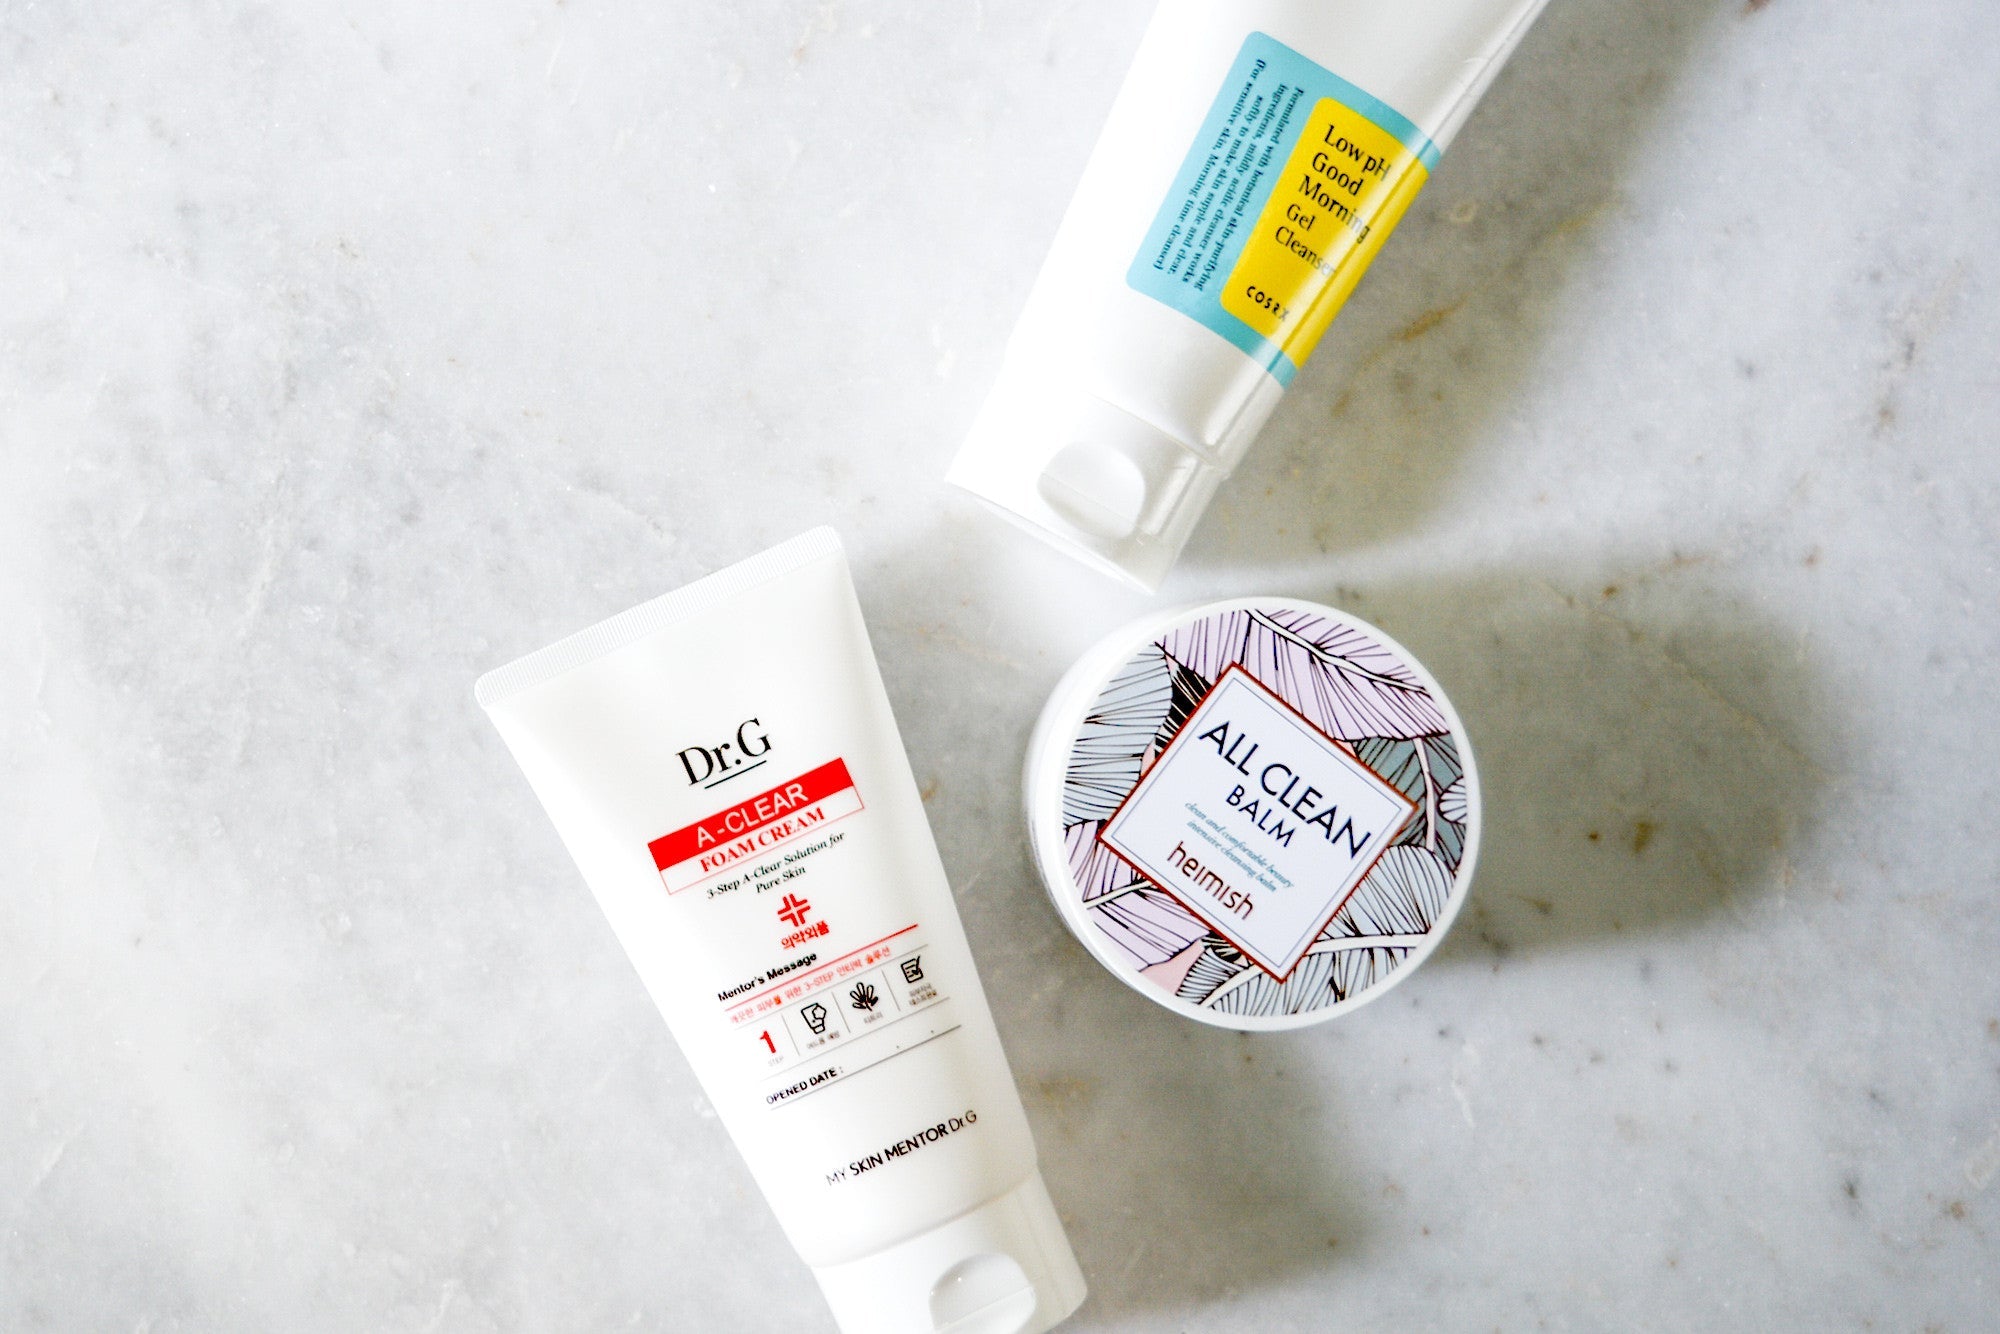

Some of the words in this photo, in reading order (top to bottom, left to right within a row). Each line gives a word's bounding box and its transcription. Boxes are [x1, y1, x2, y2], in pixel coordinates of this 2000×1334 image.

[1249, 58, 1267, 80] (For
[1227, 81, 1254, 126] sensitive
[1244, 94, 1264, 125] softly
[1270, 86, 1305, 145] Formulated
[1223, 138, 1242, 167] make
[1238, 126, 1250, 137] to
[1324, 124, 1364, 162] Low
[1362, 156, 1391, 182] pH
[1188, 153, 1220, 198] Morning
[1235, 142, 1258, 177] mildly
[1257, 145, 1275, 168] with
[1312, 152, 1364, 196] Good
[1211, 168, 1228, 190] skin
[1220, 177, 1240, 208] acidic
[1233, 169, 1265, 217] botanical
[1178, 199, 1195, 223] time
[1193, 191, 1215, 225] supple
[1198, 208, 1225, 251] cleanser
[1286, 204, 1316, 231] Gel
[1298, 174, 1370, 244] Morning
[1182, 226, 1198, 249] and
[1193, 216, 1238, 292] skin-purifying
[1182, 252, 1203, 283] works
[675, 718, 771, 786] Dr.G
[1198, 721, 1259, 776] ALL
[1260, 763, 1371, 859] CLEAN
[696, 782, 809, 848] A-CLEAR
[1225, 784, 1296, 848] BALM
[699, 838, 757, 873] FOAM
[757, 806, 825, 847] CREAM
[1184, 802, 1207, 821] clean
[1205, 818, 1227, 834] and
[1221, 827, 1268, 868] comfortable
[1265, 863, 1294, 888] beauty
[706, 878, 741, 899] 3-Step
[743, 861, 782, 884] A-Clear
[783, 841, 828, 866] Solution
[827, 831, 846, 848] for
[755, 878, 780, 894] Pure
[782, 867, 806, 882] Skin
[1166, 841, 1254, 921] heimish
[1220, 847, 1258, 879] cleansing
[1255, 872, 1277, 893] balm
[717, 976, 766, 1002] Mentor's
[766, 953, 818, 981] Message
[803, 971, 834, 991] 3-STEP
[759, 1030, 777, 1054] 1
[765, 1080, 807, 1105] OPENED
[808, 1068, 838, 1087] DATE
[826, 1168, 847, 1186] MY
[849, 1152, 883, 1176] SKIN
[884, 1123, 949, 1162] MENTOR
